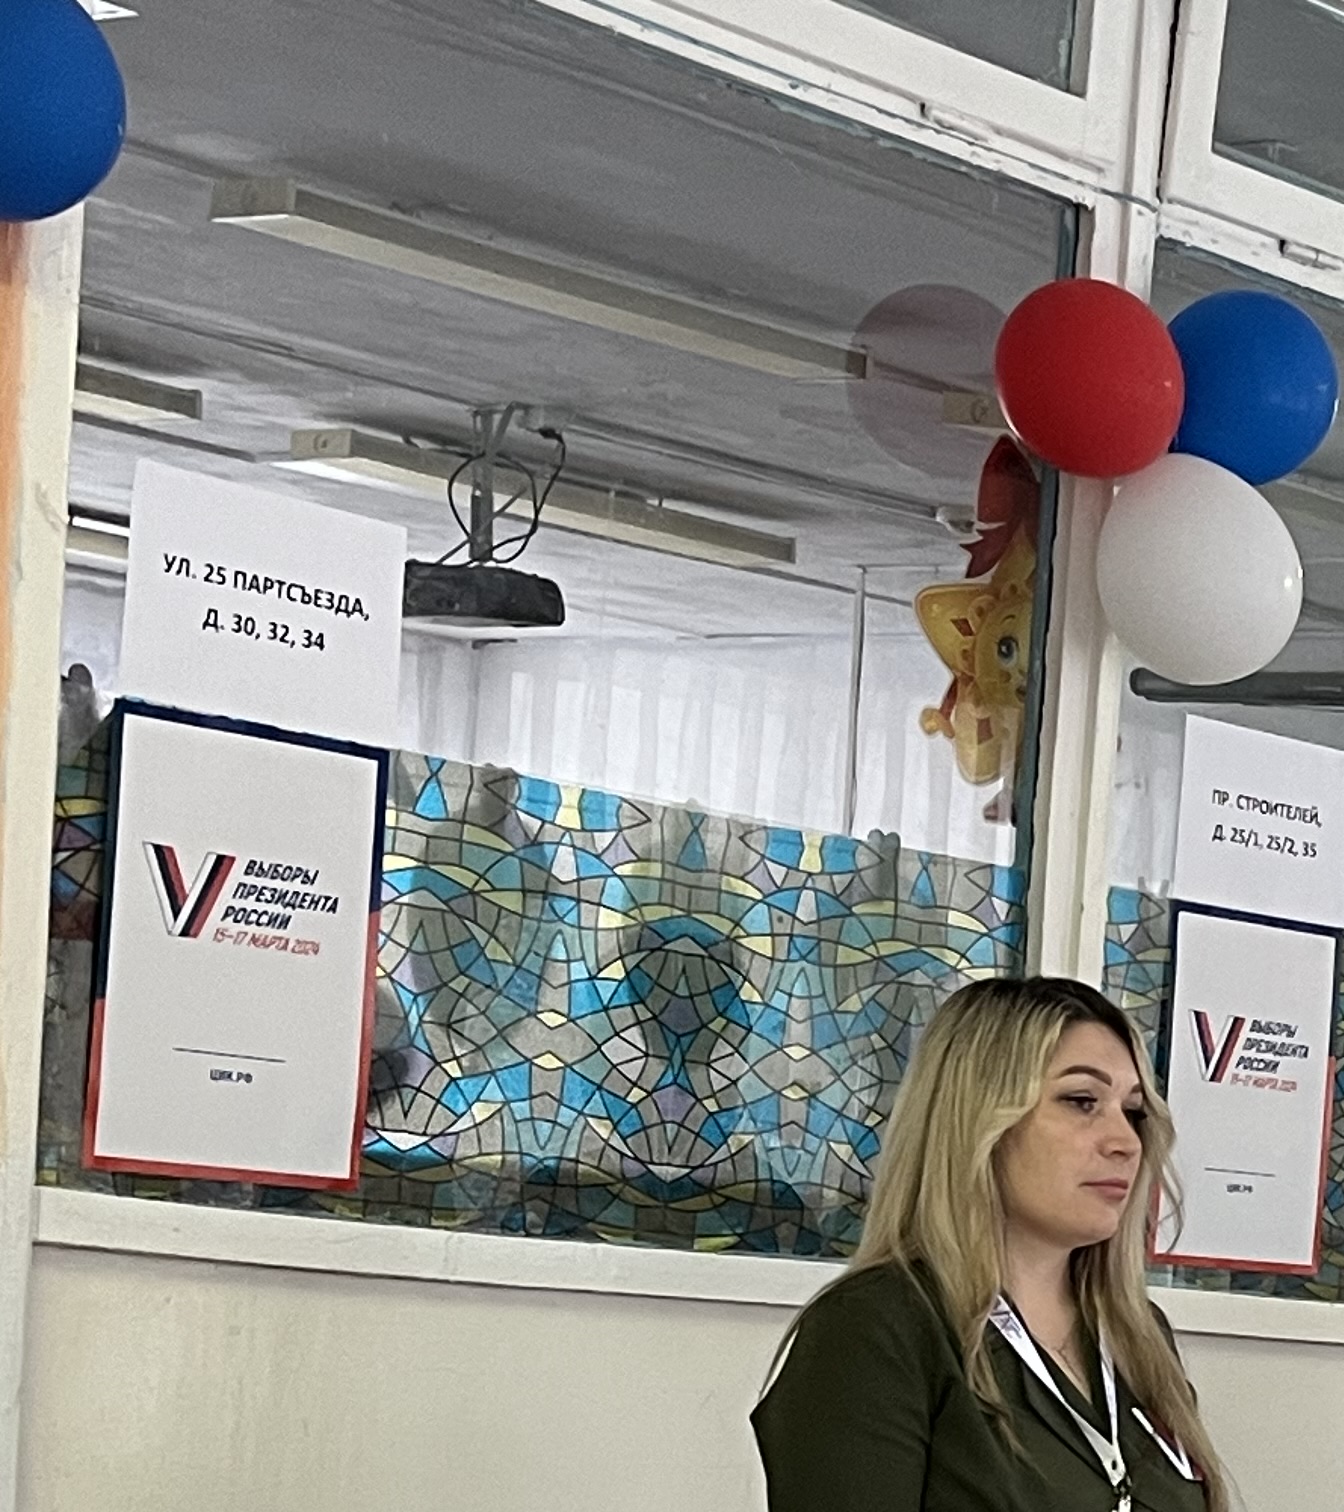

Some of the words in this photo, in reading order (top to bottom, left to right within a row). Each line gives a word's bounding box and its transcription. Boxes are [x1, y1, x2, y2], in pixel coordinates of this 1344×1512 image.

[163, 552, 197, 579] УЛ.
[203, 563, 227, 585] 25
[233, 570, 370, 621] ПАРТСЪЕЗДА,
[202, 608, 225, 632] Д.
[231, 613, 261, 639] 30,
[267, 621, 296, 647] 32,
[301, 629, 326, 651] 34
[243, 859, 319, 885] ВЫБОРЫ
[232, 881, 339, 914] ПРЕЗИДЕНТА
[220, 905, 292, 929] РОССИИ
